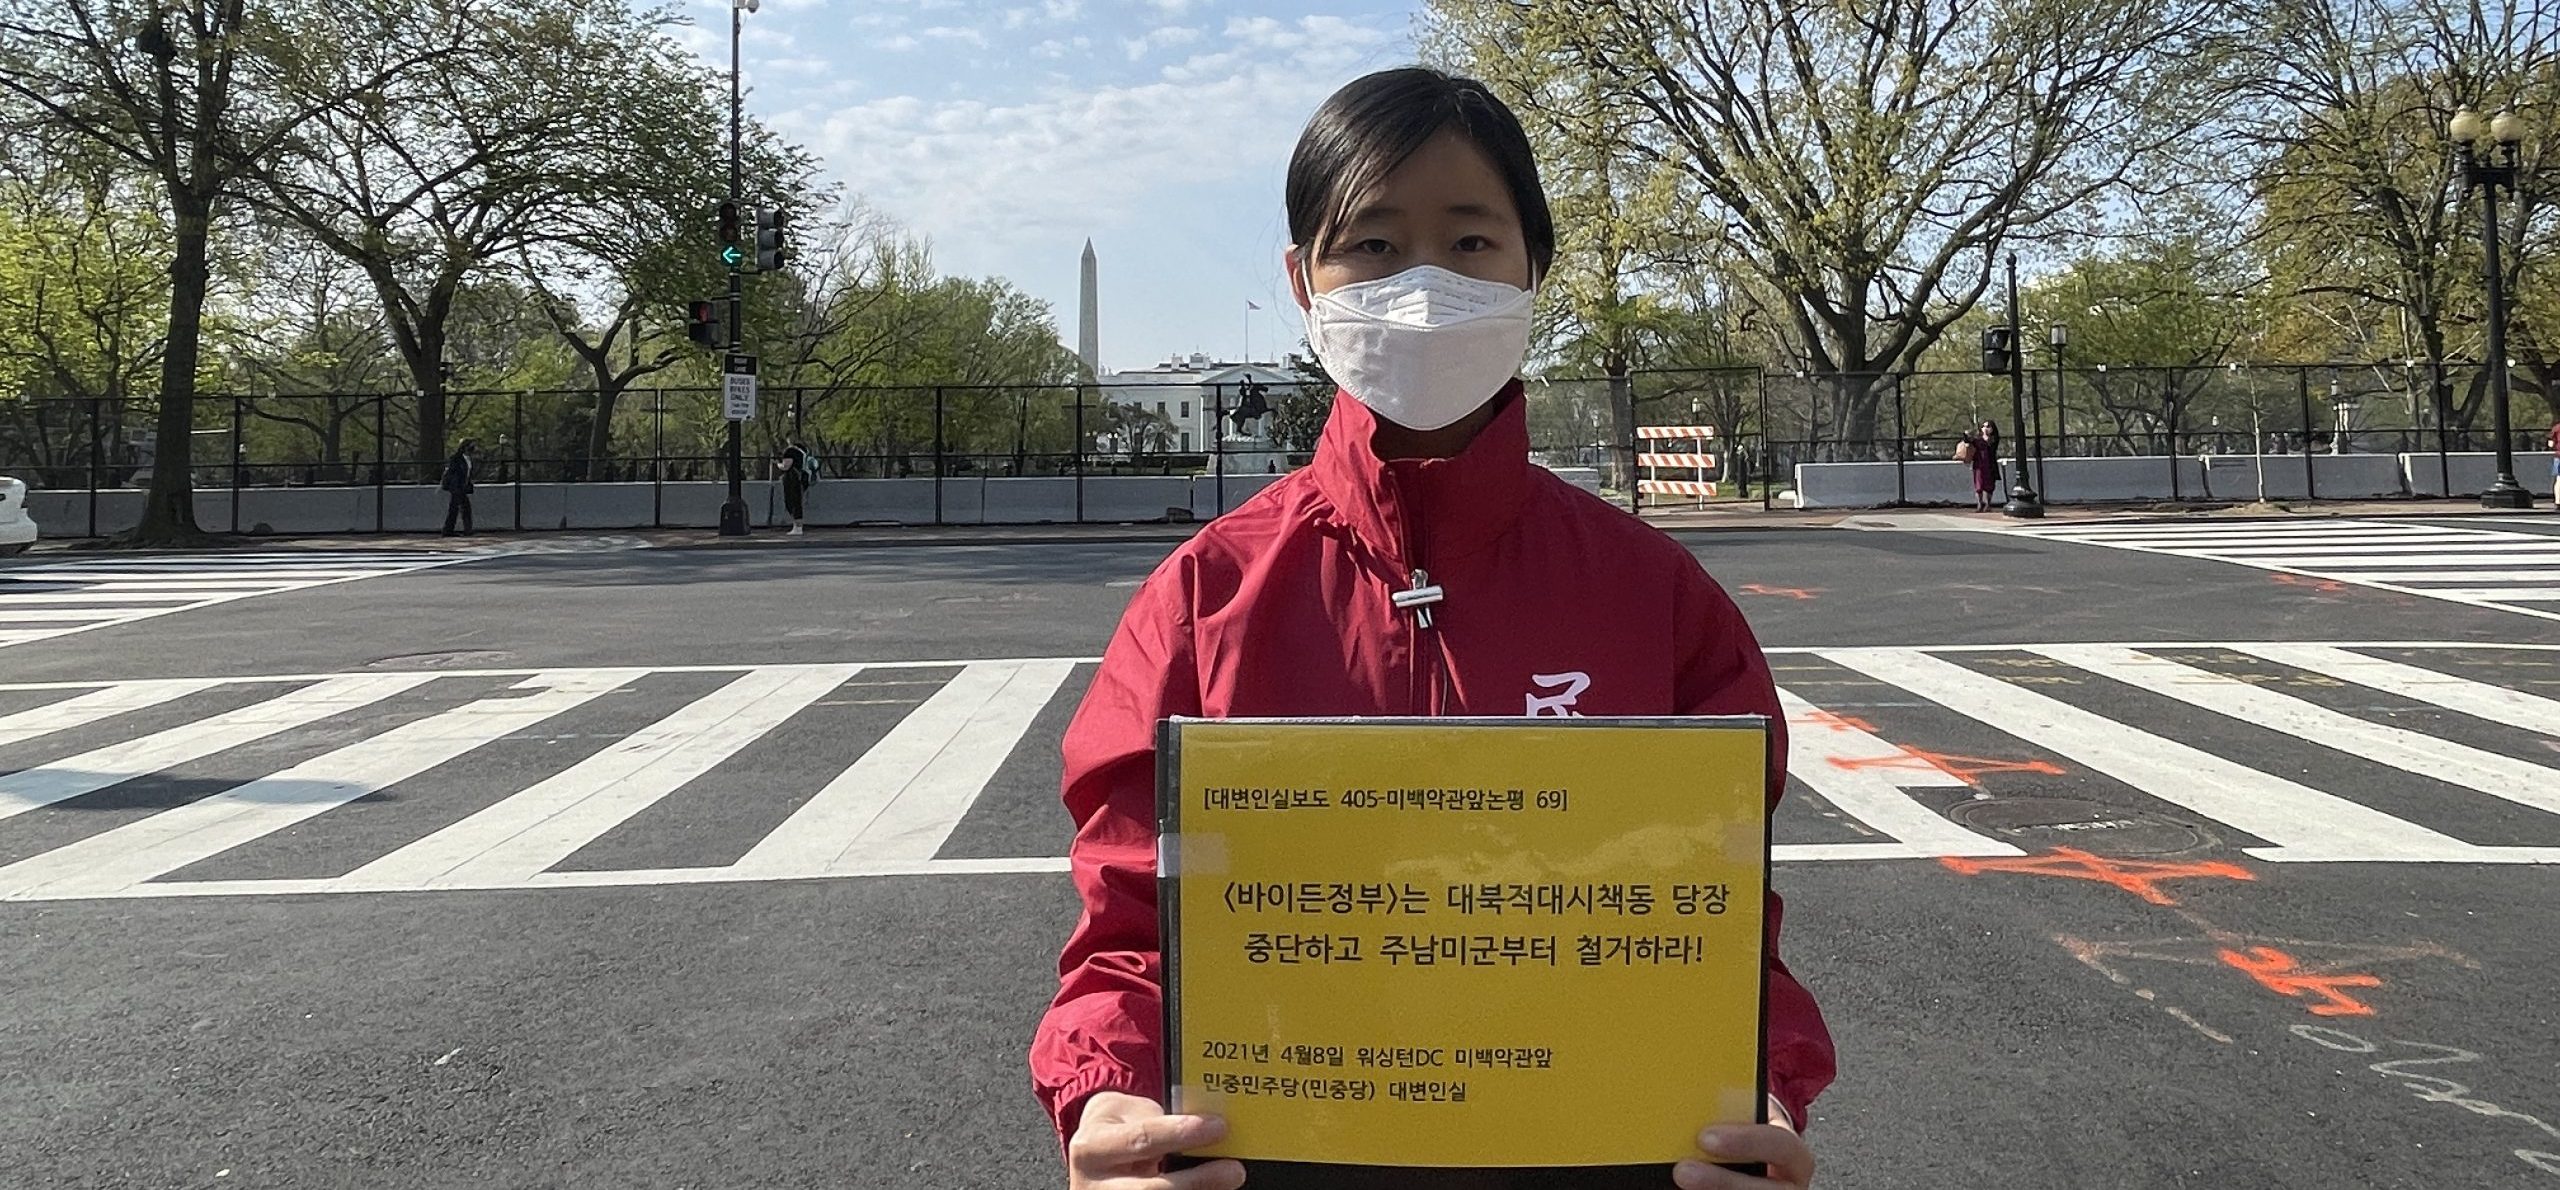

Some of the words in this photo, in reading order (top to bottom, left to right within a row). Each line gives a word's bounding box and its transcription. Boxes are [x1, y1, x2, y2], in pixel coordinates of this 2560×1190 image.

[1203, 787, 1330, 811] [대변인실보도
[1340, 788, 1524, 812] 405-미백악관앞논평
[1536, 789, 1568, 812] 69]
[1447, 883, 1656, 916] 대북적대시책동
[1672, 884, 1730, 915] 당장
[1243, 933, 1363, 965] 중단하고
[1379, 933, 1556, 967] 주남미군부터
[1575, 934, 1703, 966] 철거하라!
[1202, 1040, 1269, 1064] 2021년
[1280, 1044, 1344, 1067] 4월8일
[1355, 1046, 1444, 1069] 워싱턴DC
[1455, 1047, 1553, 1069] 미백악관앞
[1202, 1072, 1376, 1101] 민중민주당(민중당)
[1388, 1080, 1467, 1103] 대변인실
